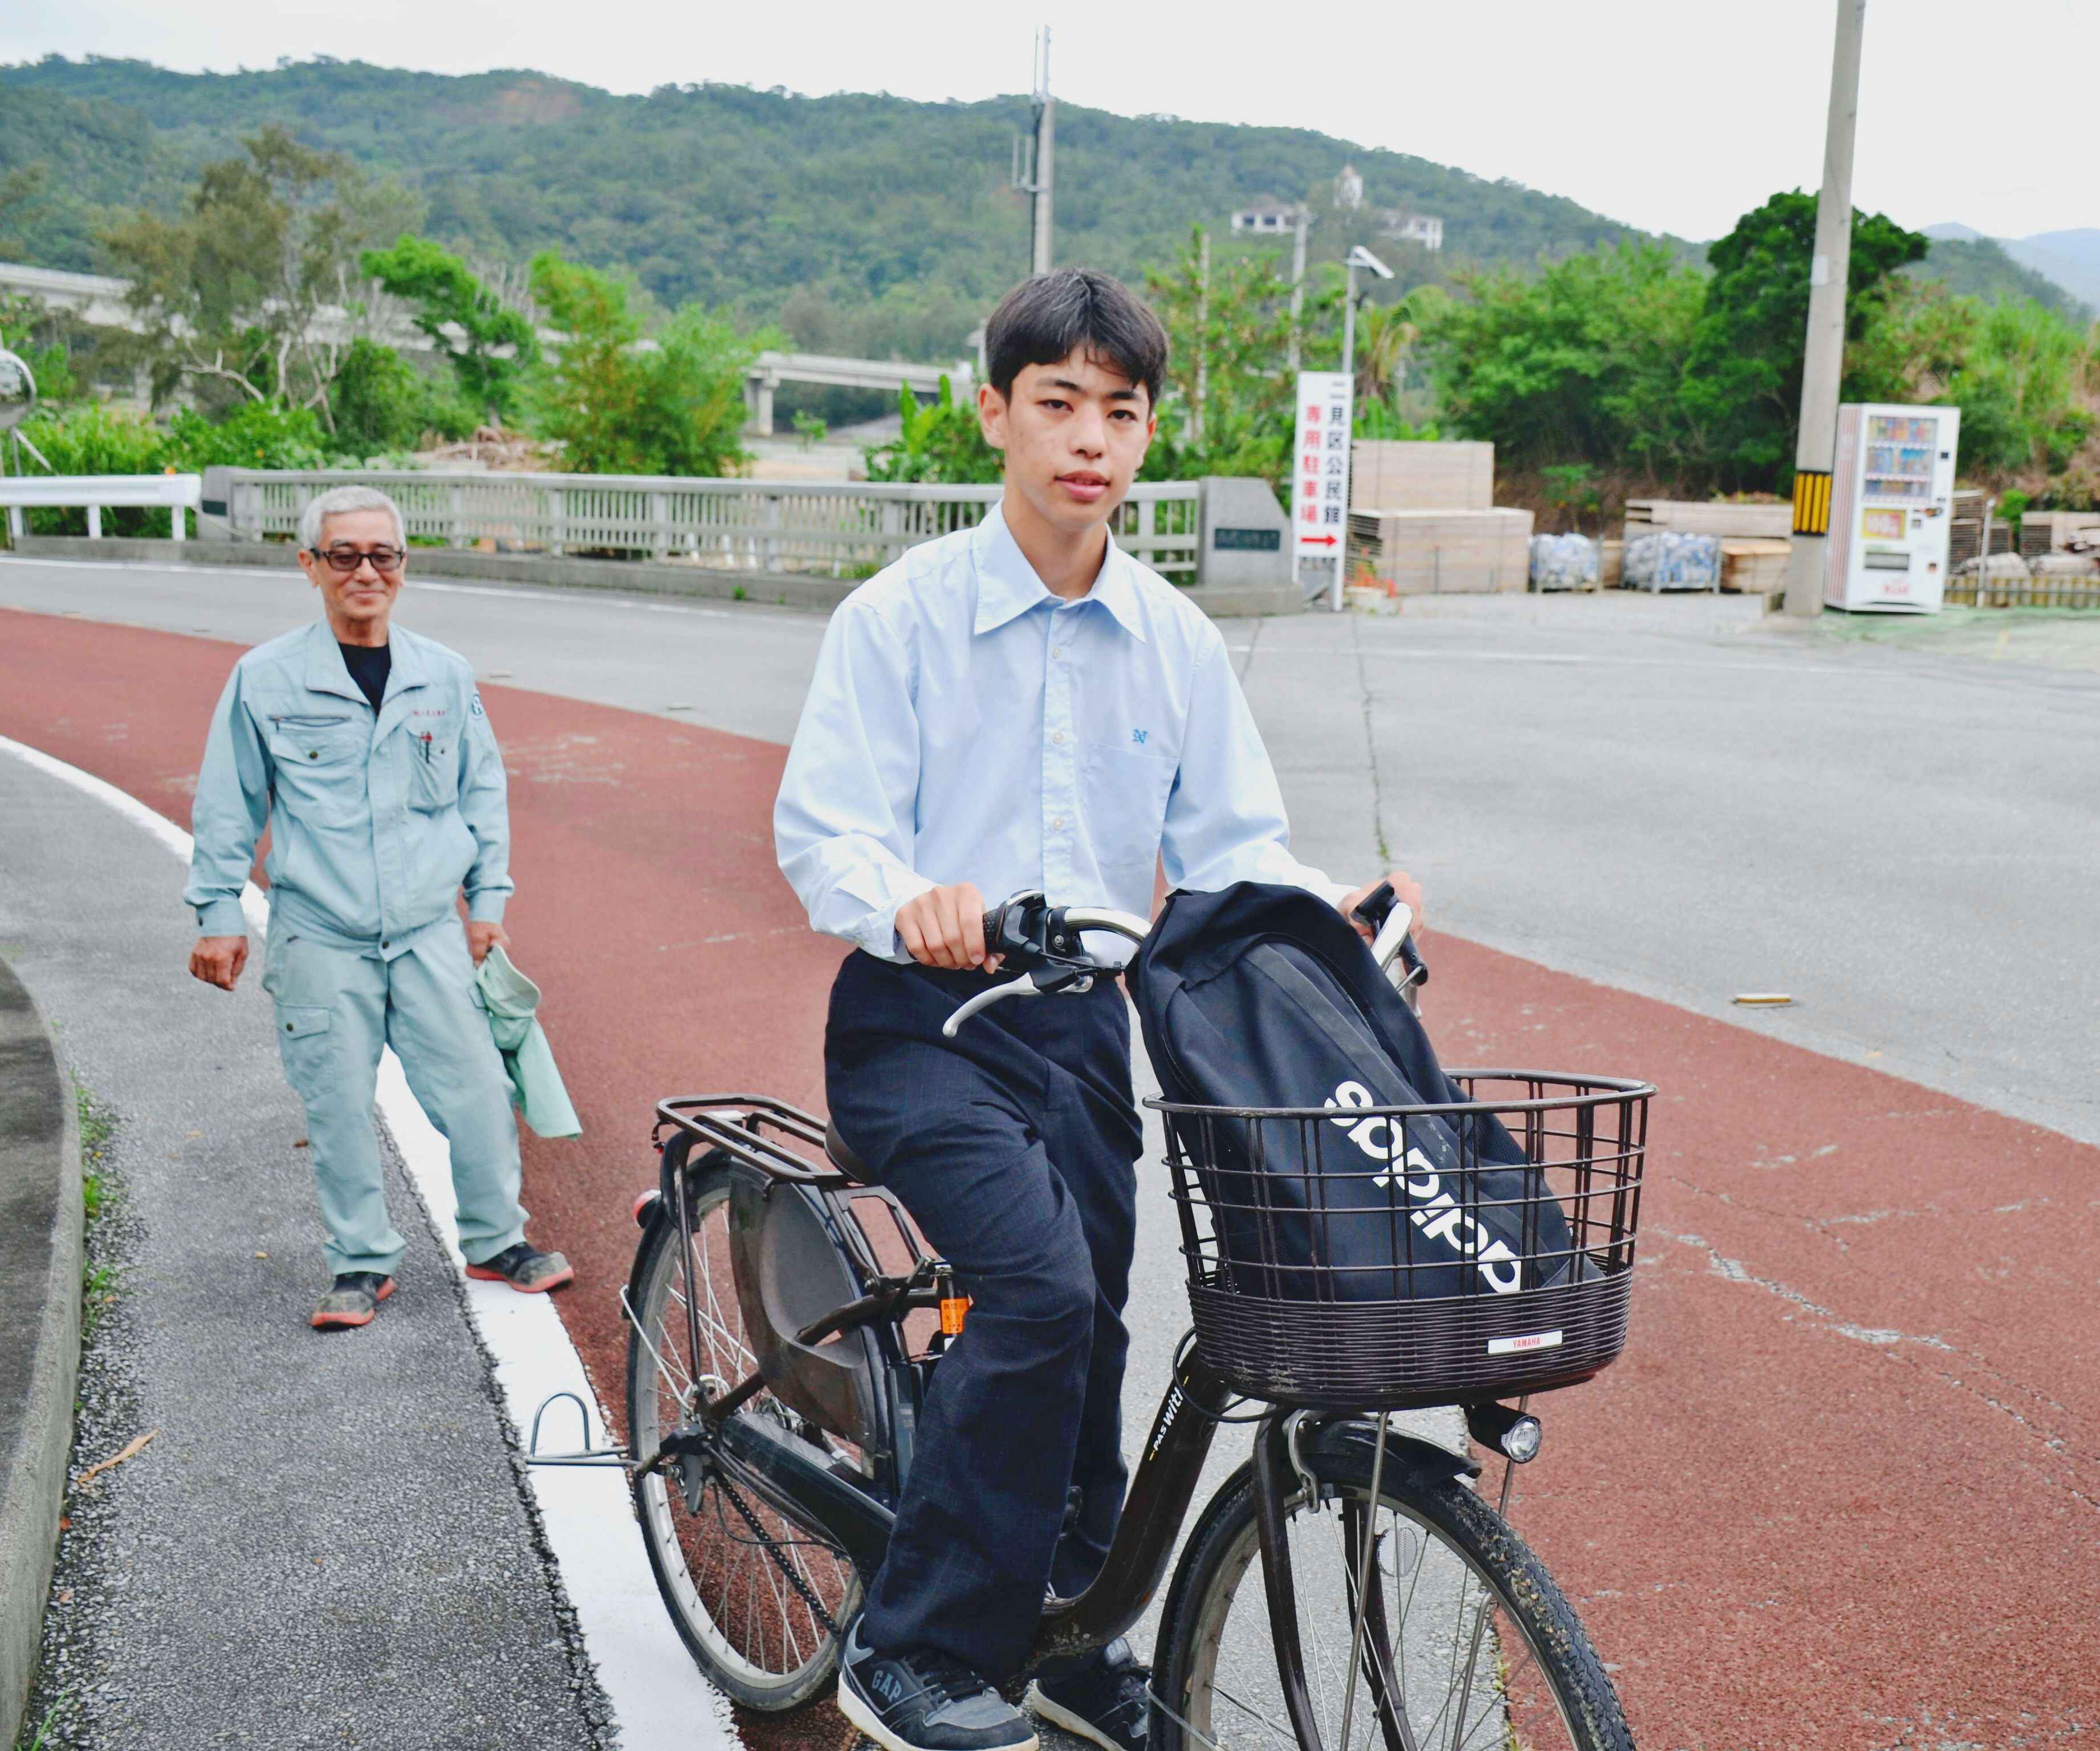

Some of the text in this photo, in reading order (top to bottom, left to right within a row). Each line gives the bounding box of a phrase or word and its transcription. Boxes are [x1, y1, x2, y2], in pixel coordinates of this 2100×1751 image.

[1300, 405, 1321, 524] 専用駐車場
[1324, 381, 1346, 525] 二見区公民館
[1324, 1081, 1522, 1293] adidas
[1513, 1336, 1541, 1348] YAMAHA
[1153, 1425, 1167, 1451] PAS
[872, 1670, 902, 1703] GAP
